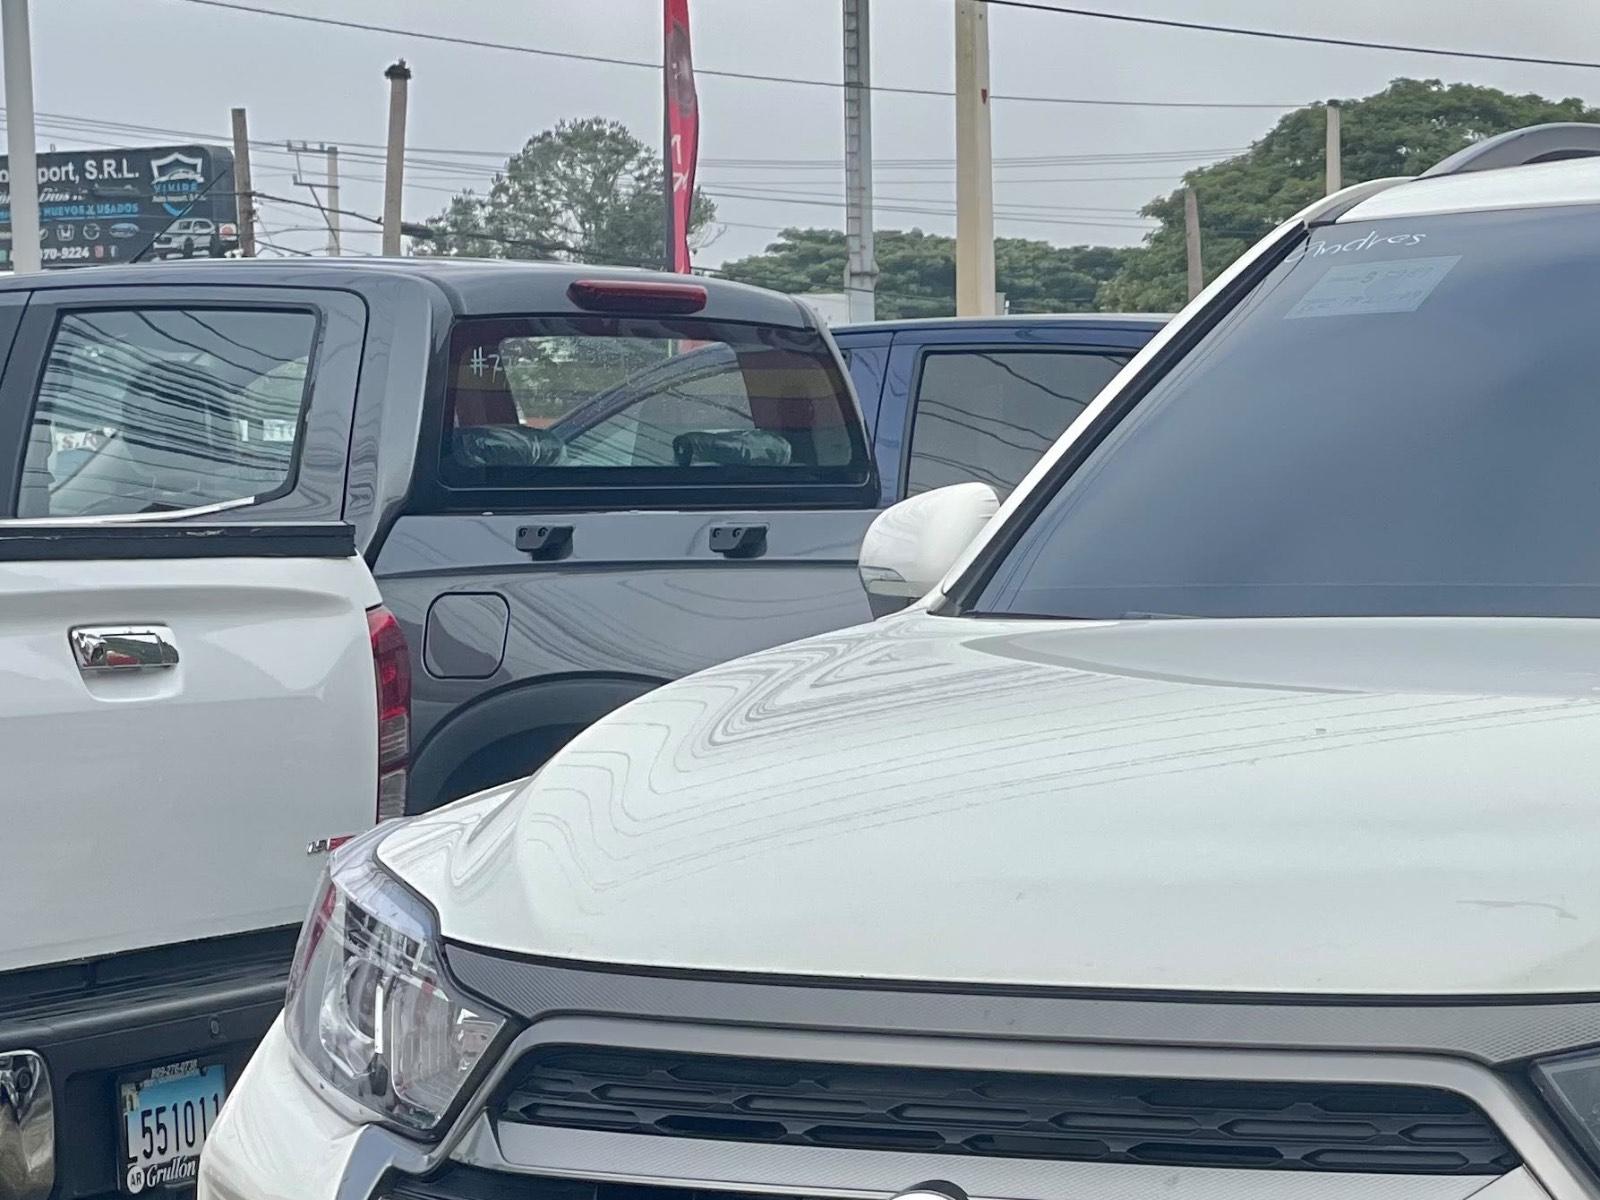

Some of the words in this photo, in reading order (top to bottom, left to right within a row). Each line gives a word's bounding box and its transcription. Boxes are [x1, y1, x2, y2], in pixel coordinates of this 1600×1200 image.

[85, 158, 139, 181] S.R.L.
[97, 202, 139, 215] USADOS
[146, 1154, 196, 1188] Grullón
